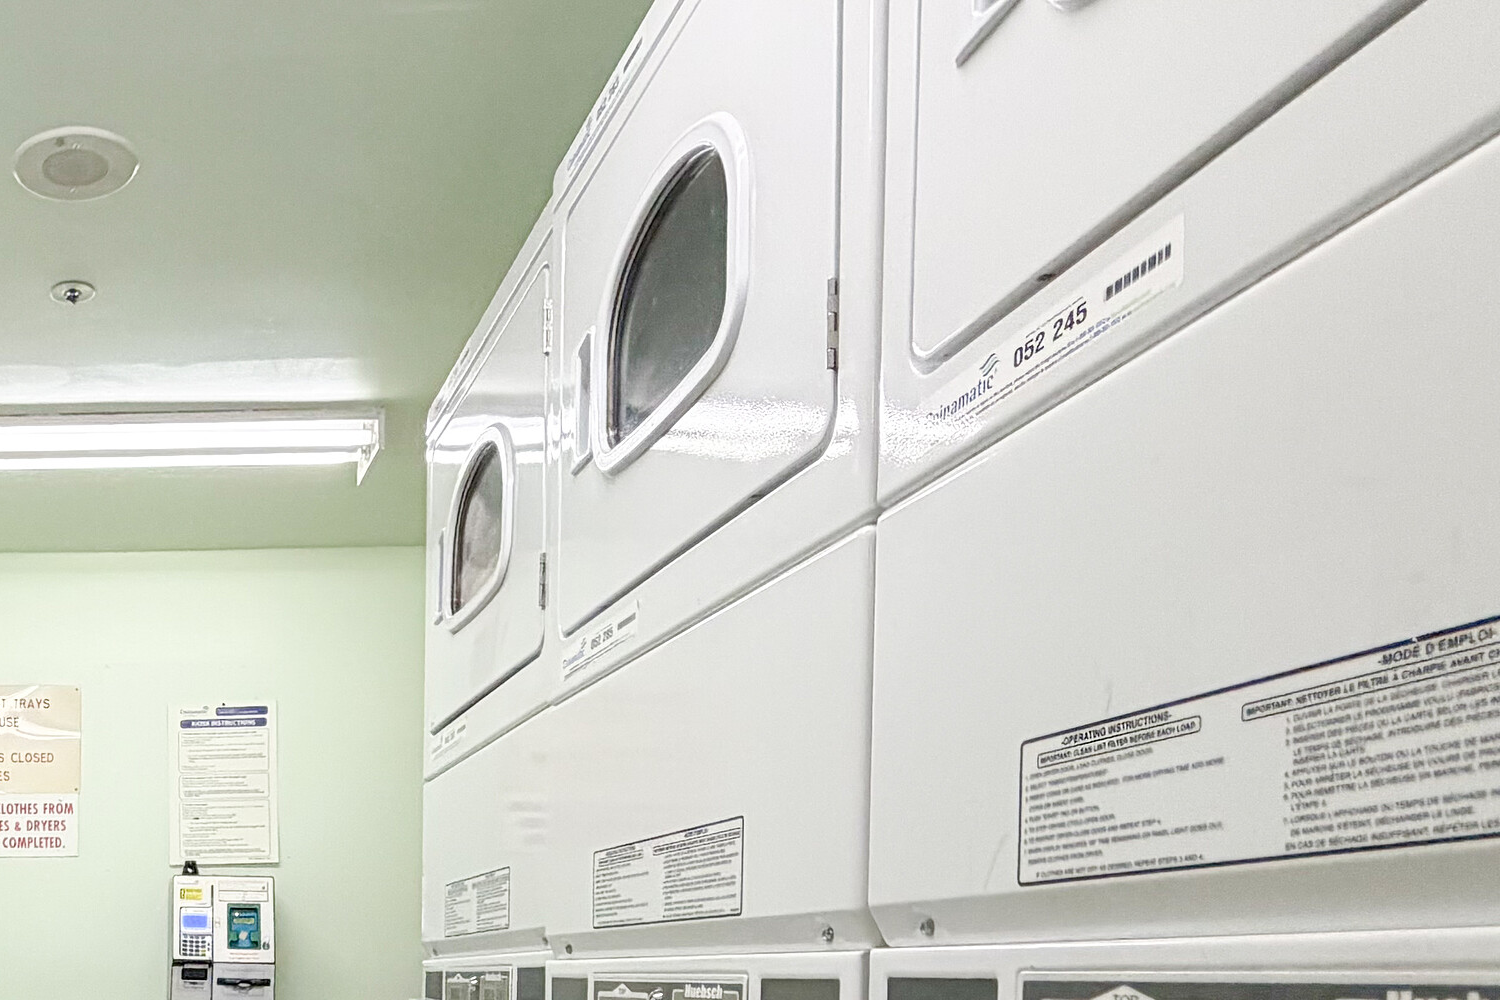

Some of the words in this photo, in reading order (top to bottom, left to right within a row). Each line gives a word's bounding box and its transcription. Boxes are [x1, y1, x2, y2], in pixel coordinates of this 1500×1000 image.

[1013, 331, 1046, 368] 052
[1052, 300, 1088, 342] 245
[14, 698, 51, 709] TRAYS
[0, 716, 20, 728] USE
[10, 752, 54, 764] CLOSED
[43, 803, 74, 815] FROM
[14, 821, 22, 832] &
[26, 820, 67, 832] DRYERS
[2, 837, 66, 849] COMPLETED.
[684, 983, 723, 1000] Huebsch
